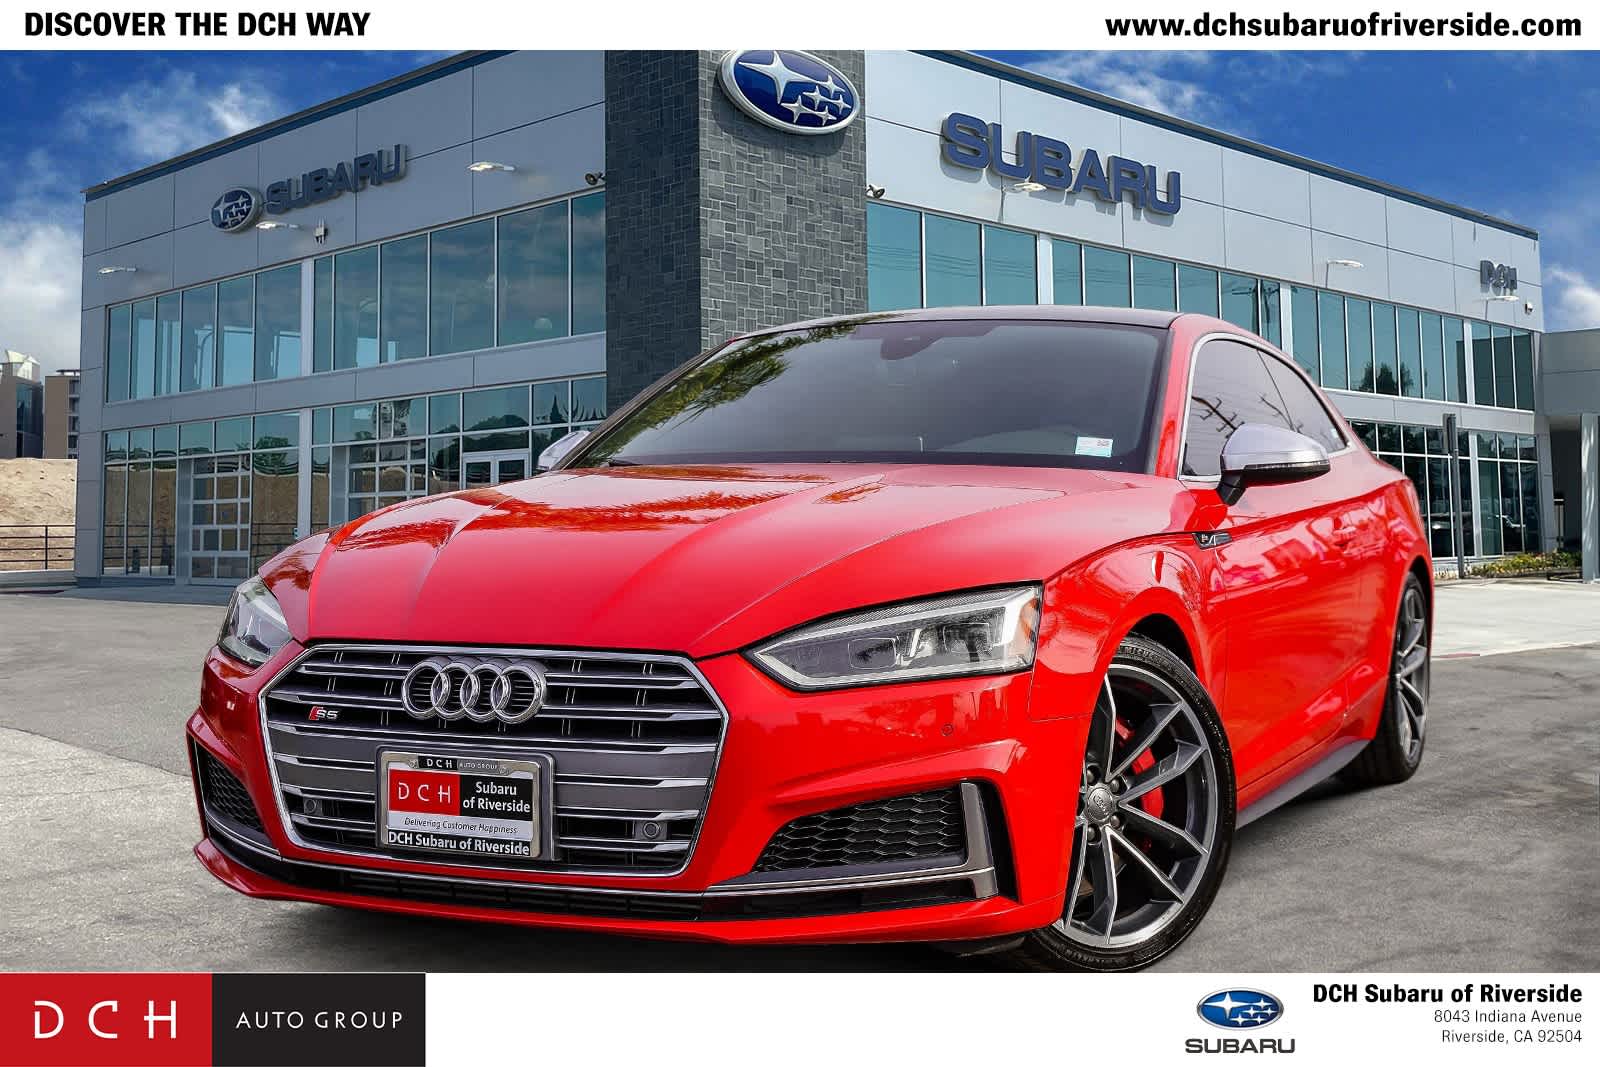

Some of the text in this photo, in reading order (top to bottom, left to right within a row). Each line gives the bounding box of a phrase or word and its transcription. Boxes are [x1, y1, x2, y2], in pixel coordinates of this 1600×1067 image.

[942, 112, 1181, 215] SUBARU
[265, 143, 406, 214] SUBARU
[397, 781, 452, 804] DCH
[475, 781, 517, 796] Subaru
[462, 797, 531, 813] of Riverside
[404, 817, 518, 835] Delivering Customer Happiness
[388, 831, 530, 856] DCH Subaru of Riverside
